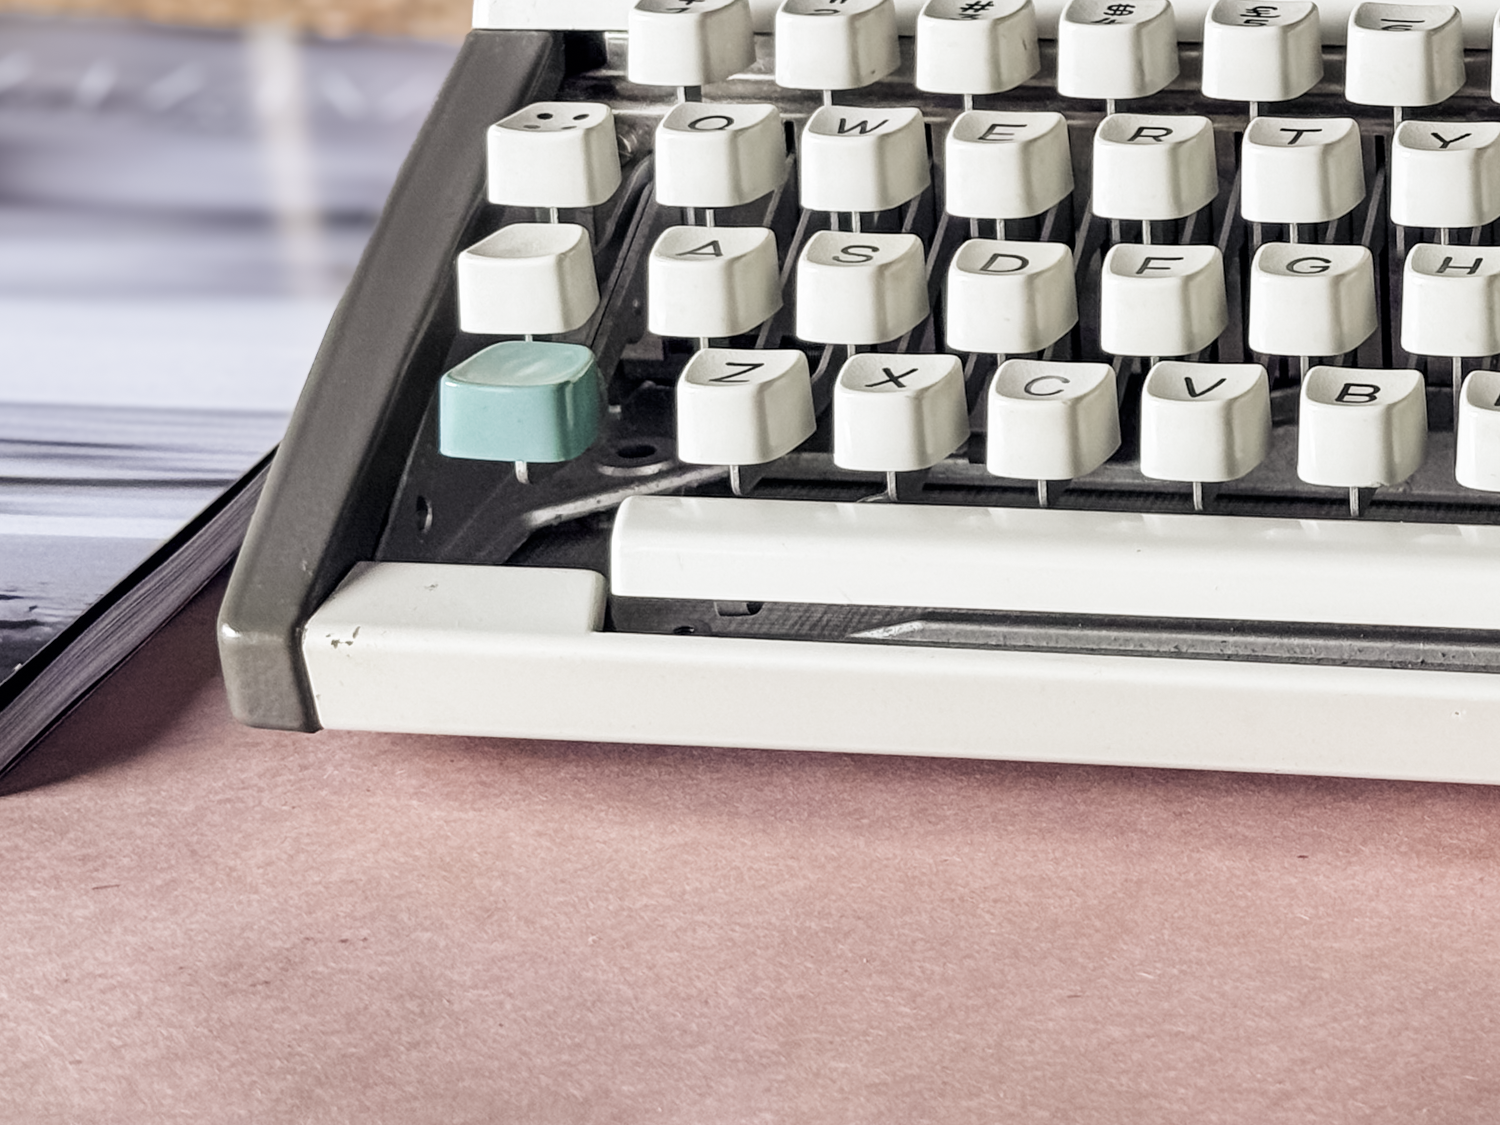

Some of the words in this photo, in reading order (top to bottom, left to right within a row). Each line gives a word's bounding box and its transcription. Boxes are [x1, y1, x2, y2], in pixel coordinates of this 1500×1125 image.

[1103, 3, 1136, 17] $
[836, 117, 894, 136] W
[977, 123, 1028, 142] E
[1126, 126, 1173, 143] R
[1279, 127, 1323, 145] T
[1430, 132, 1472, 149] Y
[675, 239, 723, 258] A
[832, 244, 880, 264] S
[979, 252, 1030, 273] D
[1135, 256, 1184, 275] F
[1285, 256, 1332, 274] G
[1435, 256, 1484, 275] H
[708, 362, 769, 384] Z
[864, 367, 919, 389] X
[1023, 375, 1070, 397] C
[1184, 376, 1227, 398] V
[1334, 382, 1381, 404] B
